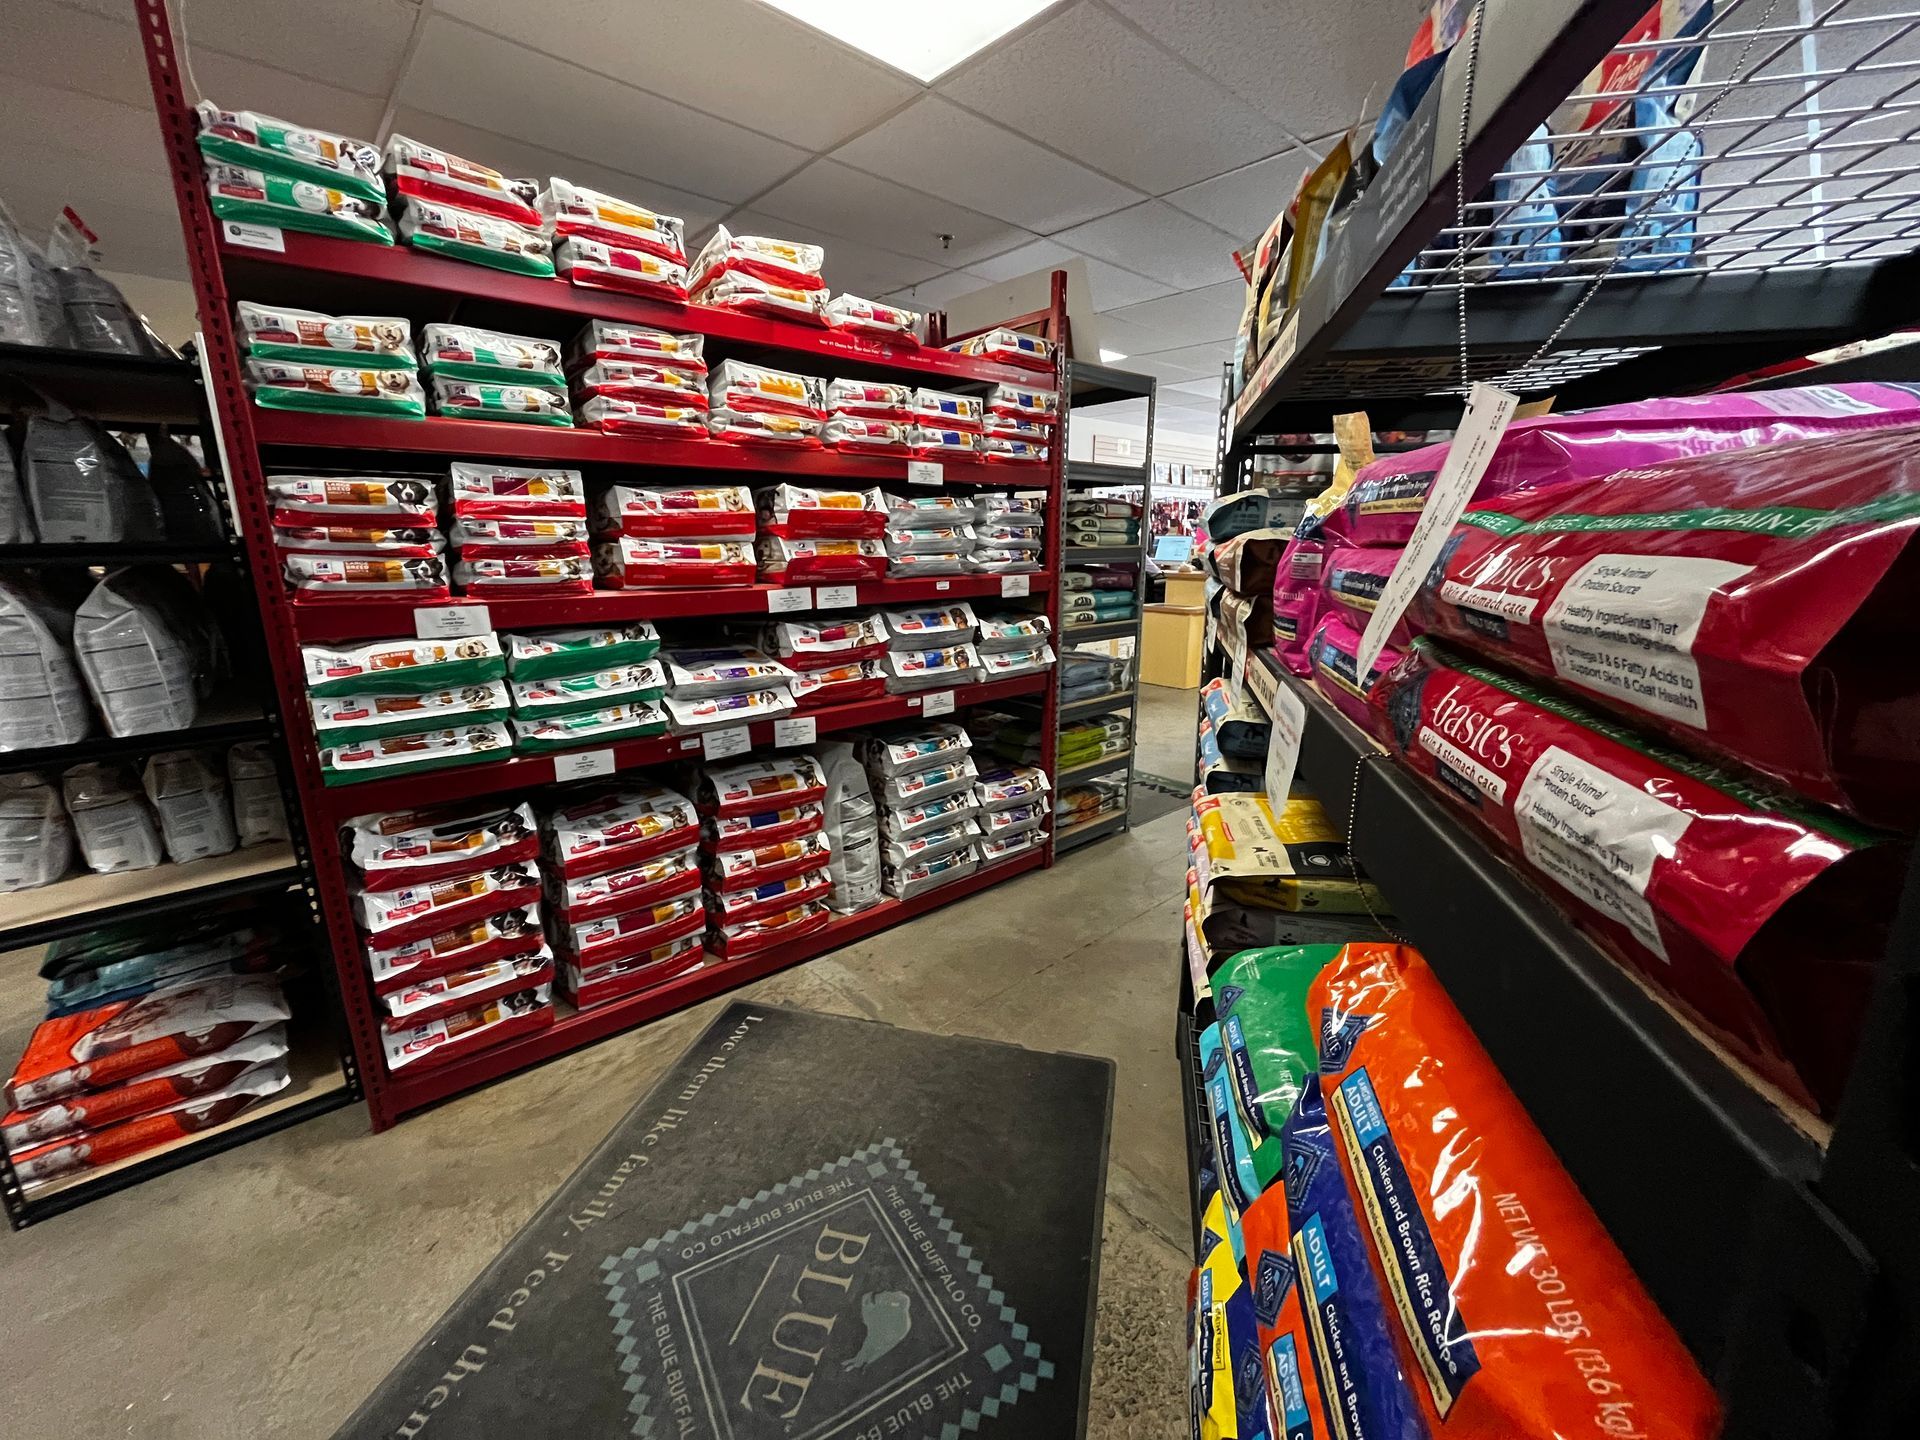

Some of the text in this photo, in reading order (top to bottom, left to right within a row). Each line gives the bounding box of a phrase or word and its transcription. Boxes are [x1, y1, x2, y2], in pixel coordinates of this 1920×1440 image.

[1608, 581, 1642, 595] Source
[1502, 601, 1527, 617] care
[1563, 603, 1594, 622] Healthy
[1651, 617, 1679, 636] That
[1613, 656, 1621, 670] 6
[1621, 658, 1647, 680] Fatty
[1649, 665, 1679, 686] Acids
[1680, 674, 1694, 690] to
[1623, 678, 1630, 690] &
[1632, 680, 1658, 699] Coat
[1657, 686, 1699, 711] Health
[1432, 685, 1525, 768] basics
[1421, 733, 1436, 748] skin
[1442, 749, 1476, 781] stomach
[1477, 774, 1498, 796] care
[1550, 765, 1608, 801] Single Animal
[1544, 777, 1598, 819] Protein Source
[1532, 801, 1561, 829] Healthy
[1608, 849, 1635, 876] That
[721, 1014, 764, 1054] Love
[1229, 1020, 1241, 1046] ADULT
[678, 1052, 728, 1101] them
[1345, 1085, 1373, 1136] ADULT
[1356, 1076, 1381, 1128] LARGE BREED
[640, 1107, 690, 1147] like
[786, 1189, 825, 1215] BLUE
[827, 1177, 857, 1196] THE
[710, 1208, 783, 1248] BUFFALO
[884, 1184, 982, 1333] THE BLUE BUFFALO CO.
[1307, 1226, 1331, 1289] ADULT
[1372, 1145, 1458, 1376] Chicken and Brown Rice Recipe
[487, 1250, 573, 1332] Feed
[647, 1292, 668, 1325] THE
[1202, 1274, 1210, 1307] ADULT
[740, 1223, 871, 1419] BLUE
[1492, 1192, 1531, 1225] NET
[1529, 1265, 1566, 1295] 30
[1564, 1348, 1622, 1395] (13.6
[1594, 1402, 1649, 1440] kg)
[655, 1323, 679, 1369] BLUE
[935, 1372, 973, 1401] THE
[1277, 1351, 1295, 1413] ADULT
[1326, 1303, 1364, 1440] Chicken and Brow
[883, 1393, 934, 1434] BLUE
